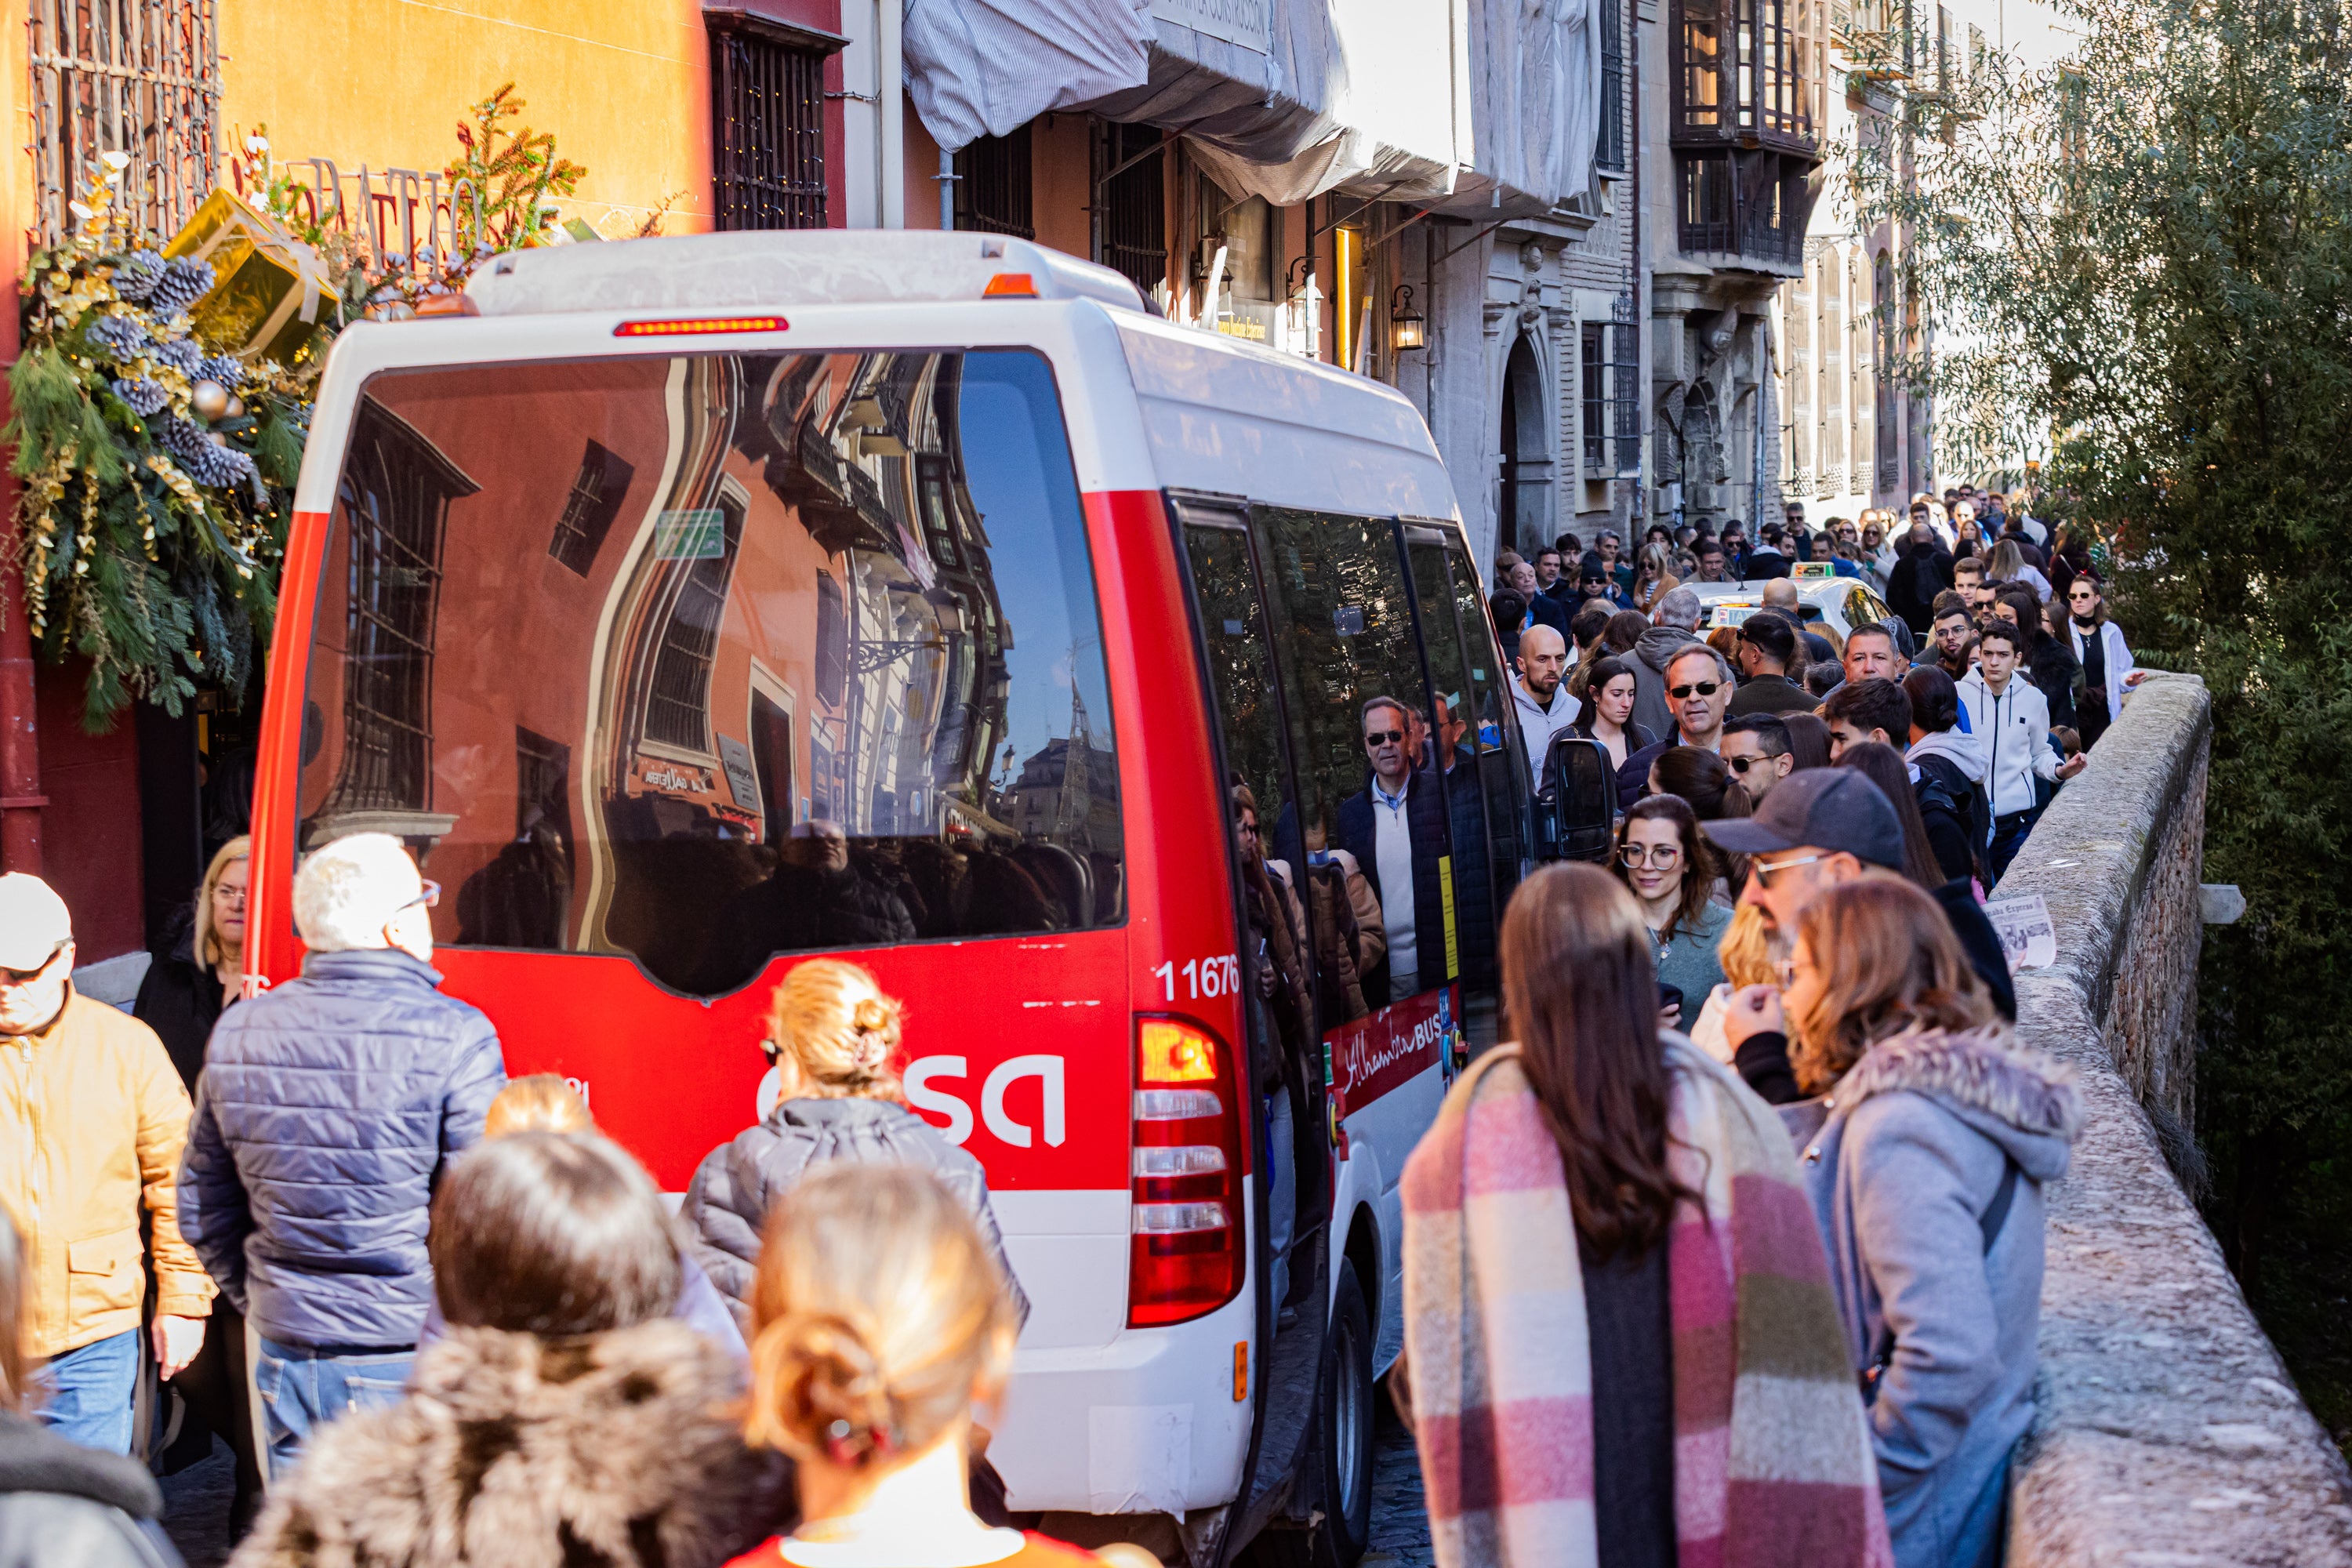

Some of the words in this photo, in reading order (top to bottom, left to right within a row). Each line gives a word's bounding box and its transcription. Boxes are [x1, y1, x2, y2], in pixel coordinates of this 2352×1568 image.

[1731, 611, 1755, 622] TAX
[2005, 903, 2034, 914] Express
[1155, 953, 1240, 1002] 11676
